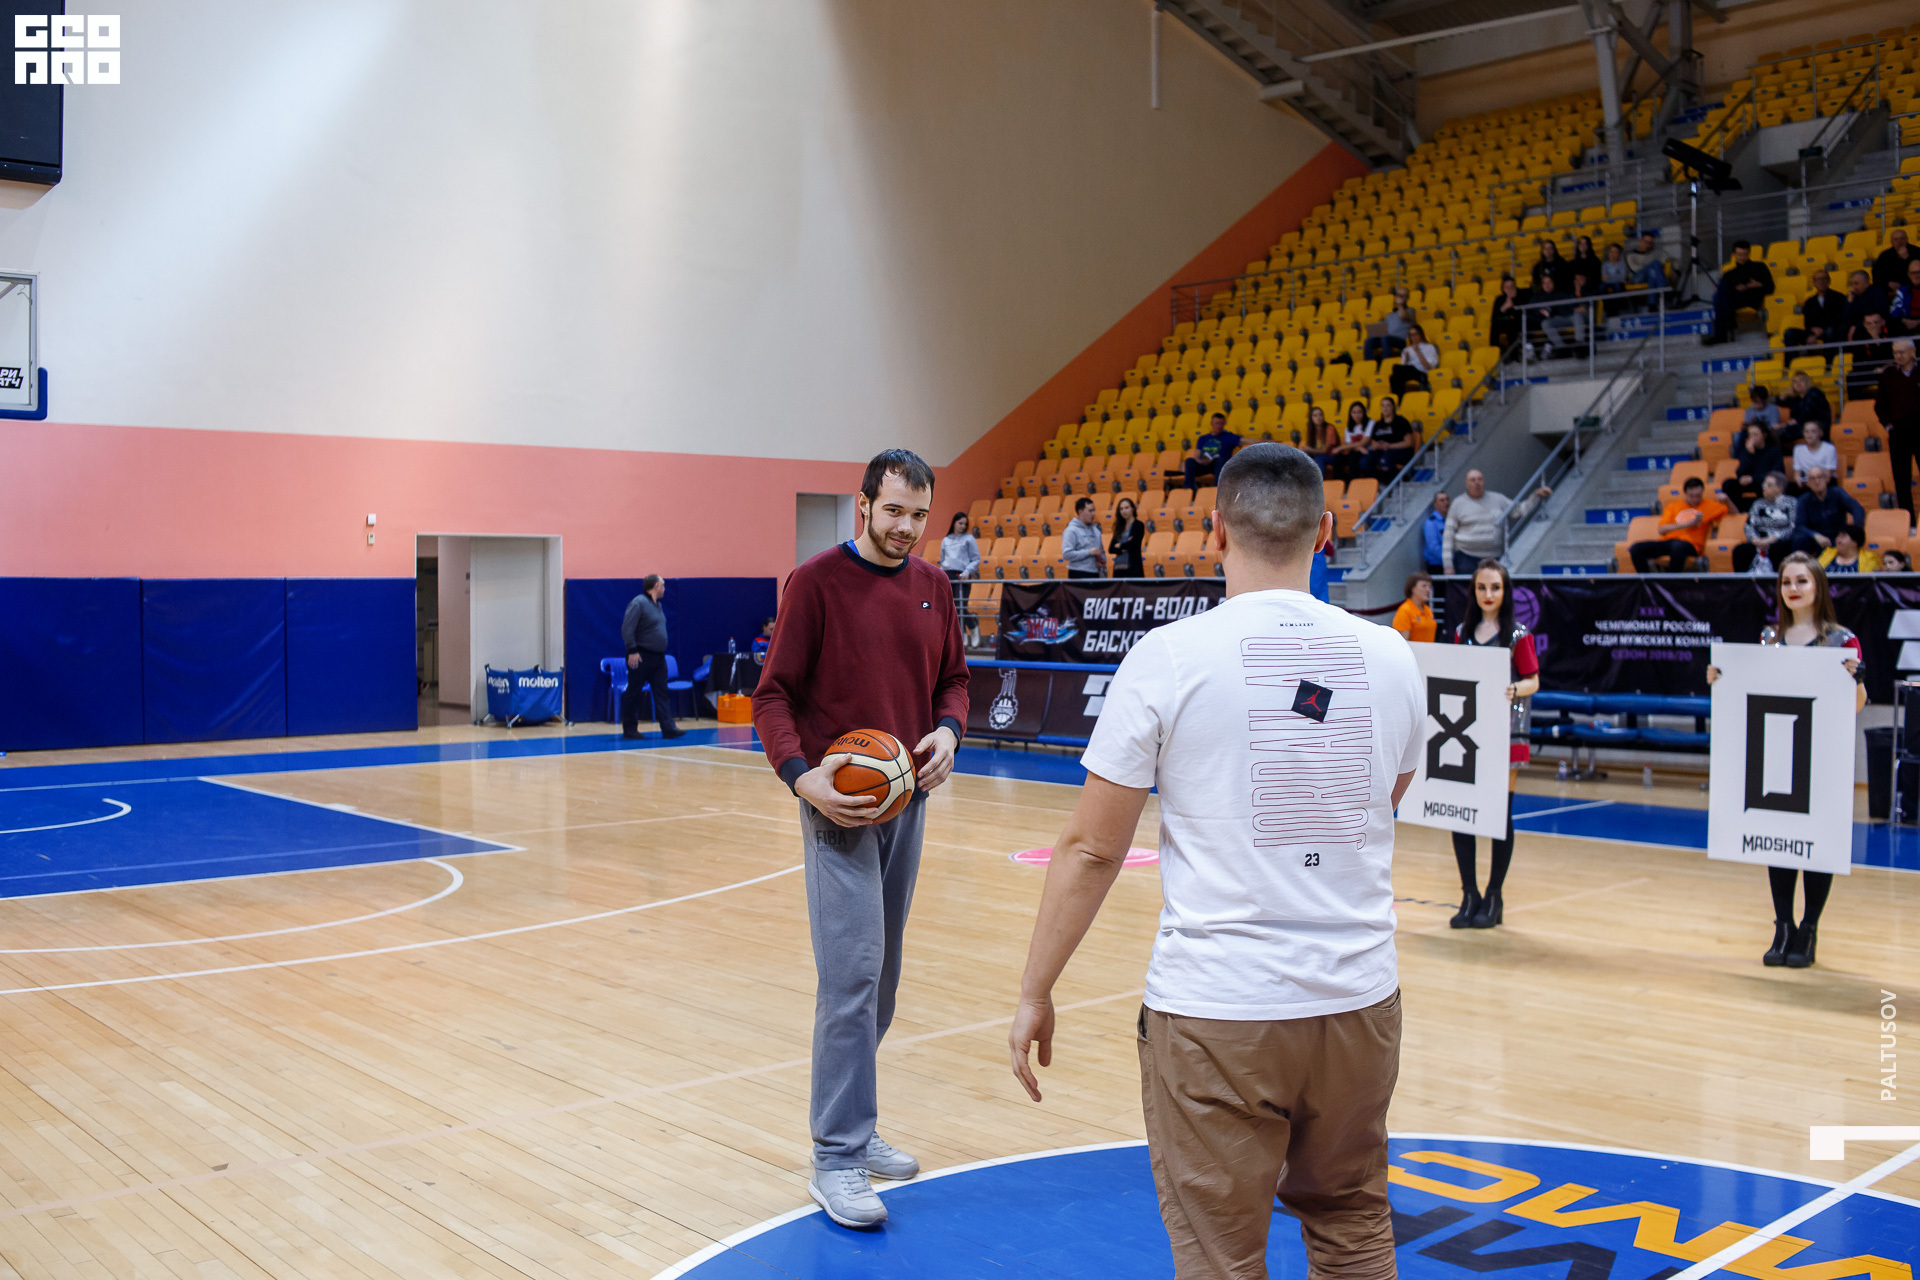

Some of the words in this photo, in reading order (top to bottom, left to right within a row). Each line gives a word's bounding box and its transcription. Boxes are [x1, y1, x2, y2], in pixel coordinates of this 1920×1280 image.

[1594, 620, 1661, 632] ЧЕМПИОНАТ
[1663, 620, 1711, 633] РОССИИ
[1583, 633, 1618, 647] СРЕДИ
[1619, 633, 1674, 647] МУЖСКИХ
[1611, 649, 1647, 660] СЕЗОН
[518, 676, 559, 688] molten
[1425, 676, 1480, 785] 8
[1248, 706, 1373, 850] JORDAN
[1423, 801, 1479, 825] MADSHOT
[815, 829, 848, 846] FIBA
[1742, 833, 1815, 860] MADSHOT
[1304, 853, 1320, 867] 23
